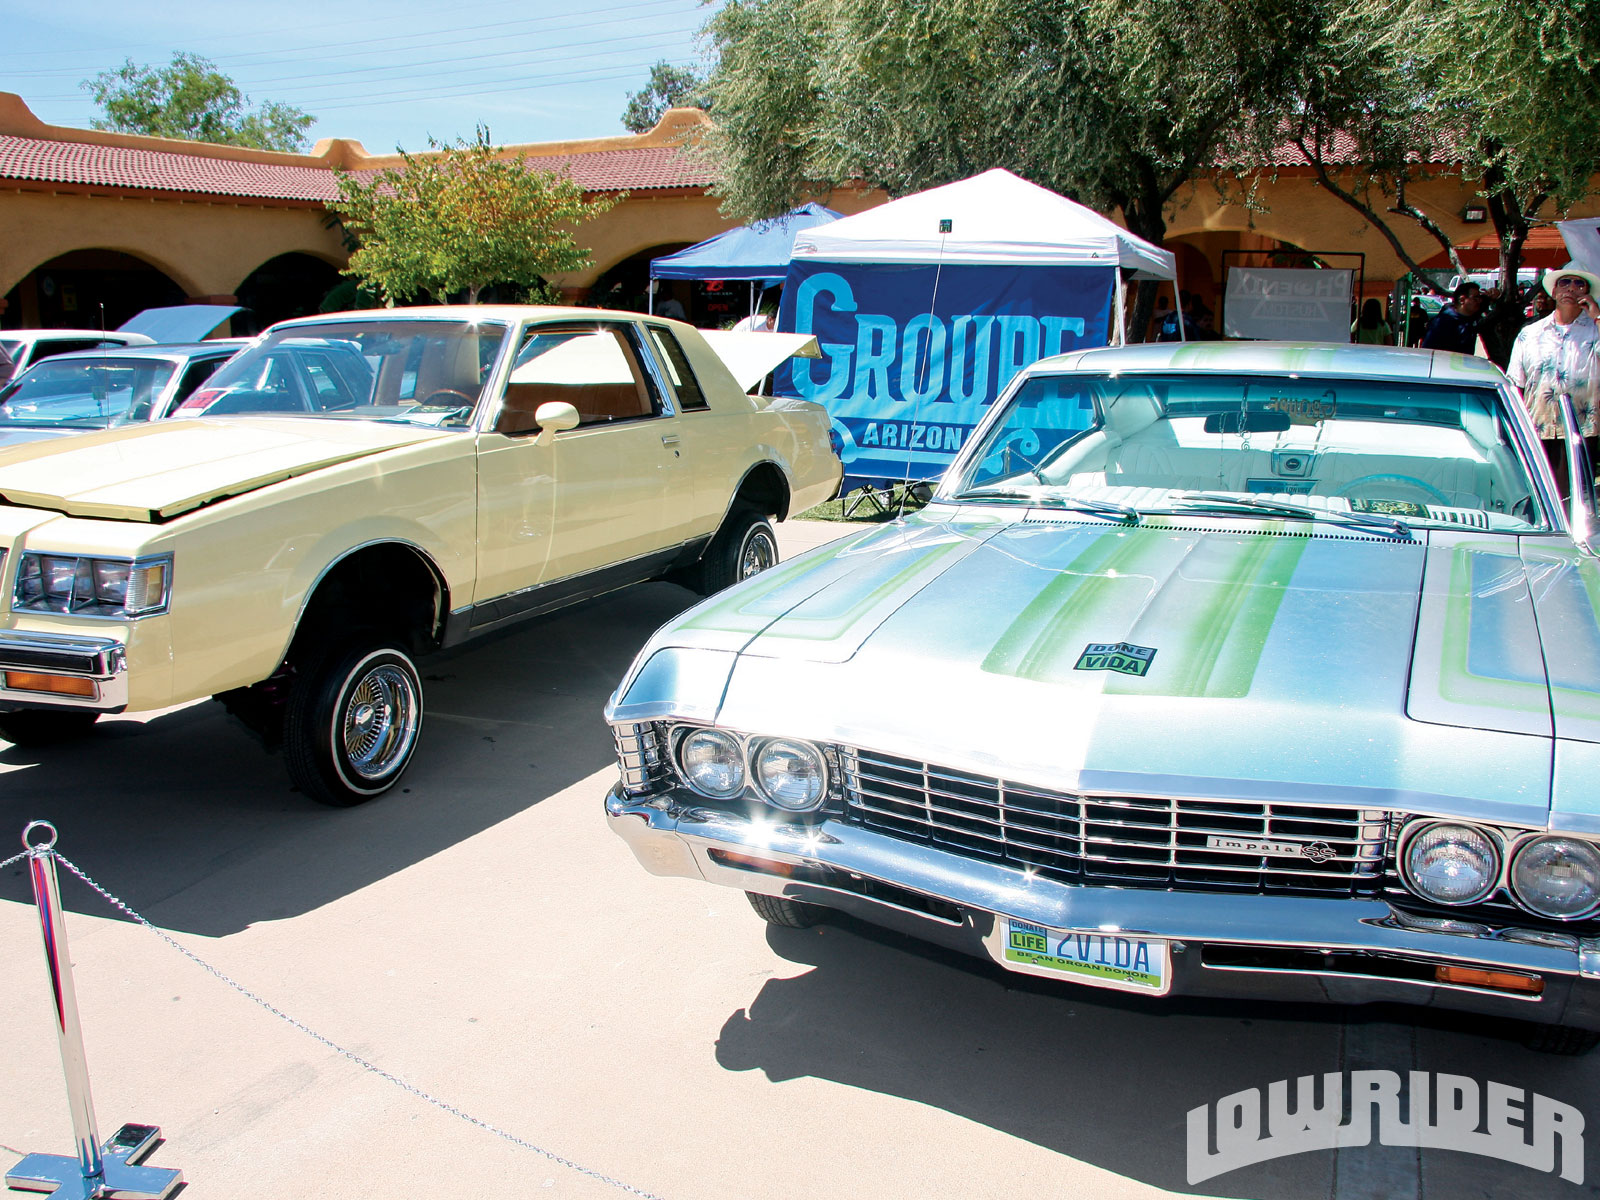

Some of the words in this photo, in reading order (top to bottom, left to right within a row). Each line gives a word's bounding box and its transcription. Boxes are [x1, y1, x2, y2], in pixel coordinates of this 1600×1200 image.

[792, 272, 1085, 406] GROUPE
[862, 422, 975, 450] ARIZON
[1086, 656, 1138, 673] VIDA
[1215, 839, 1294, 853] Impala
[1302, 845, 1337, 859] SS
[1012, 921, 1045, 933] DONATE
[1013, 934, 1045, 950] LIFE
[1056, 933, 1150, 973] 2VIDA
[1036, 954, 1053, 962] AN
[1057, 958, 1100, 971] ORGAN
[1104, 967, 1149, 980] DONOR
